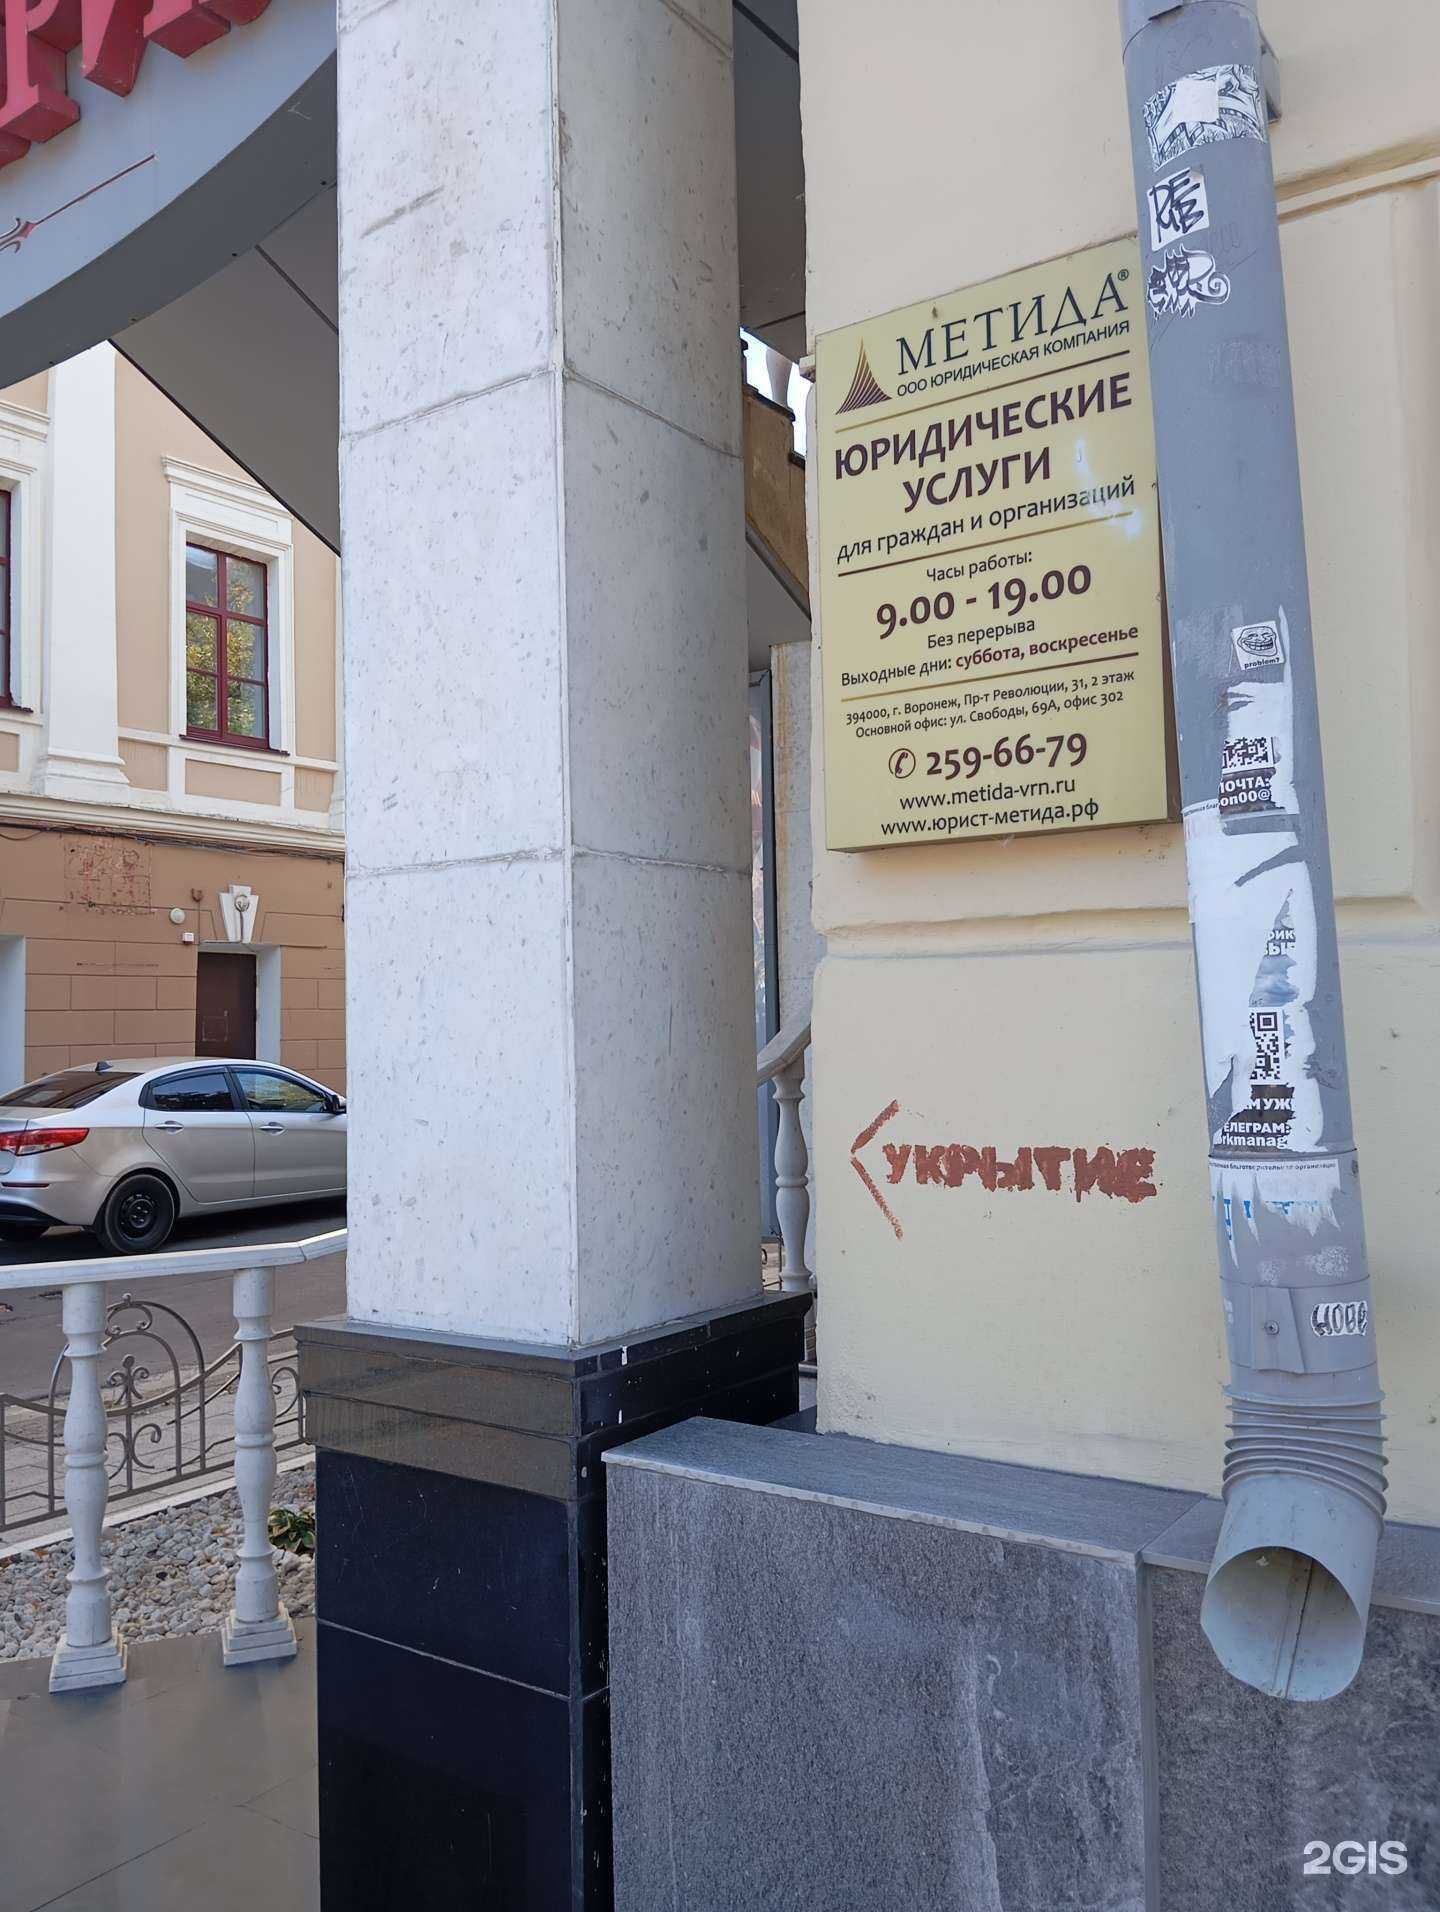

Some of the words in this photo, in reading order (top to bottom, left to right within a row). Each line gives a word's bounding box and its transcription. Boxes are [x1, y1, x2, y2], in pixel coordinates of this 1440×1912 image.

[897, 376, 928, 398] ООО
[930, 346, 1039, 389] ЮРИДИЧЕСКАЯ
[1043, 320, 1130, 356] КОМПАНИЯ
[835, 372, 1132, 480] ЮРИДИЧЕСКИЕ
[902, 446, 1051, 513] УСЛУГИ
[836, 541, 872, 564] для
[877, 517, 964, 554] граждан
[970, 513, 983, 530] и
[989, 475, 1136, 529] организаций
[926, 564, 965, 583] Часы
[968, 551, 1033, 578] работы:
[876, 590, 956, 640] 9.00
[988, 564, 1092, 617] 19.00
[841, 663, 917, 687] Выходные
[919, 658, 953, 679] дни:
[955, 646, 1026, 670] суббота,
[1029, 626, 1139, 657] воскресенье
[927, 633, 954, 649] Без
[957, 620, 1036, 647] перерыва
[846, 707, 891, 726] 394000,
[893, 707, 902, 716] г.
[904, 697, 962, 715] Воронеж,
[964, 691, 990, 706] Пр-т
[993, 681, 1069, 702] Революции,
[1071, 677, 1089, 692] 31,
[1091, 676, 1099, 686] 2
[1102, 671, 1136, 687] этаж
[855, 719, 912, 738] Основной
[914, 713, 948, 733] офис:
[949, 713, 967, 728] ул.
[969, 704, 1029, 723] Свободы,
[1031, 698, 1061, 716] 69А,
[1063, 694, 1098, 713] офис
[1100, 690, 1124, 707] 302
[926, 732, 1088, 781] 259-66-79
[881, 798, 1099, 836] www.юрист-метида.рф
[900, 776, 1076, 810] www.metida-vrn.ru
[882, 1142, 1158, 1203] УКРЫТИЕ
